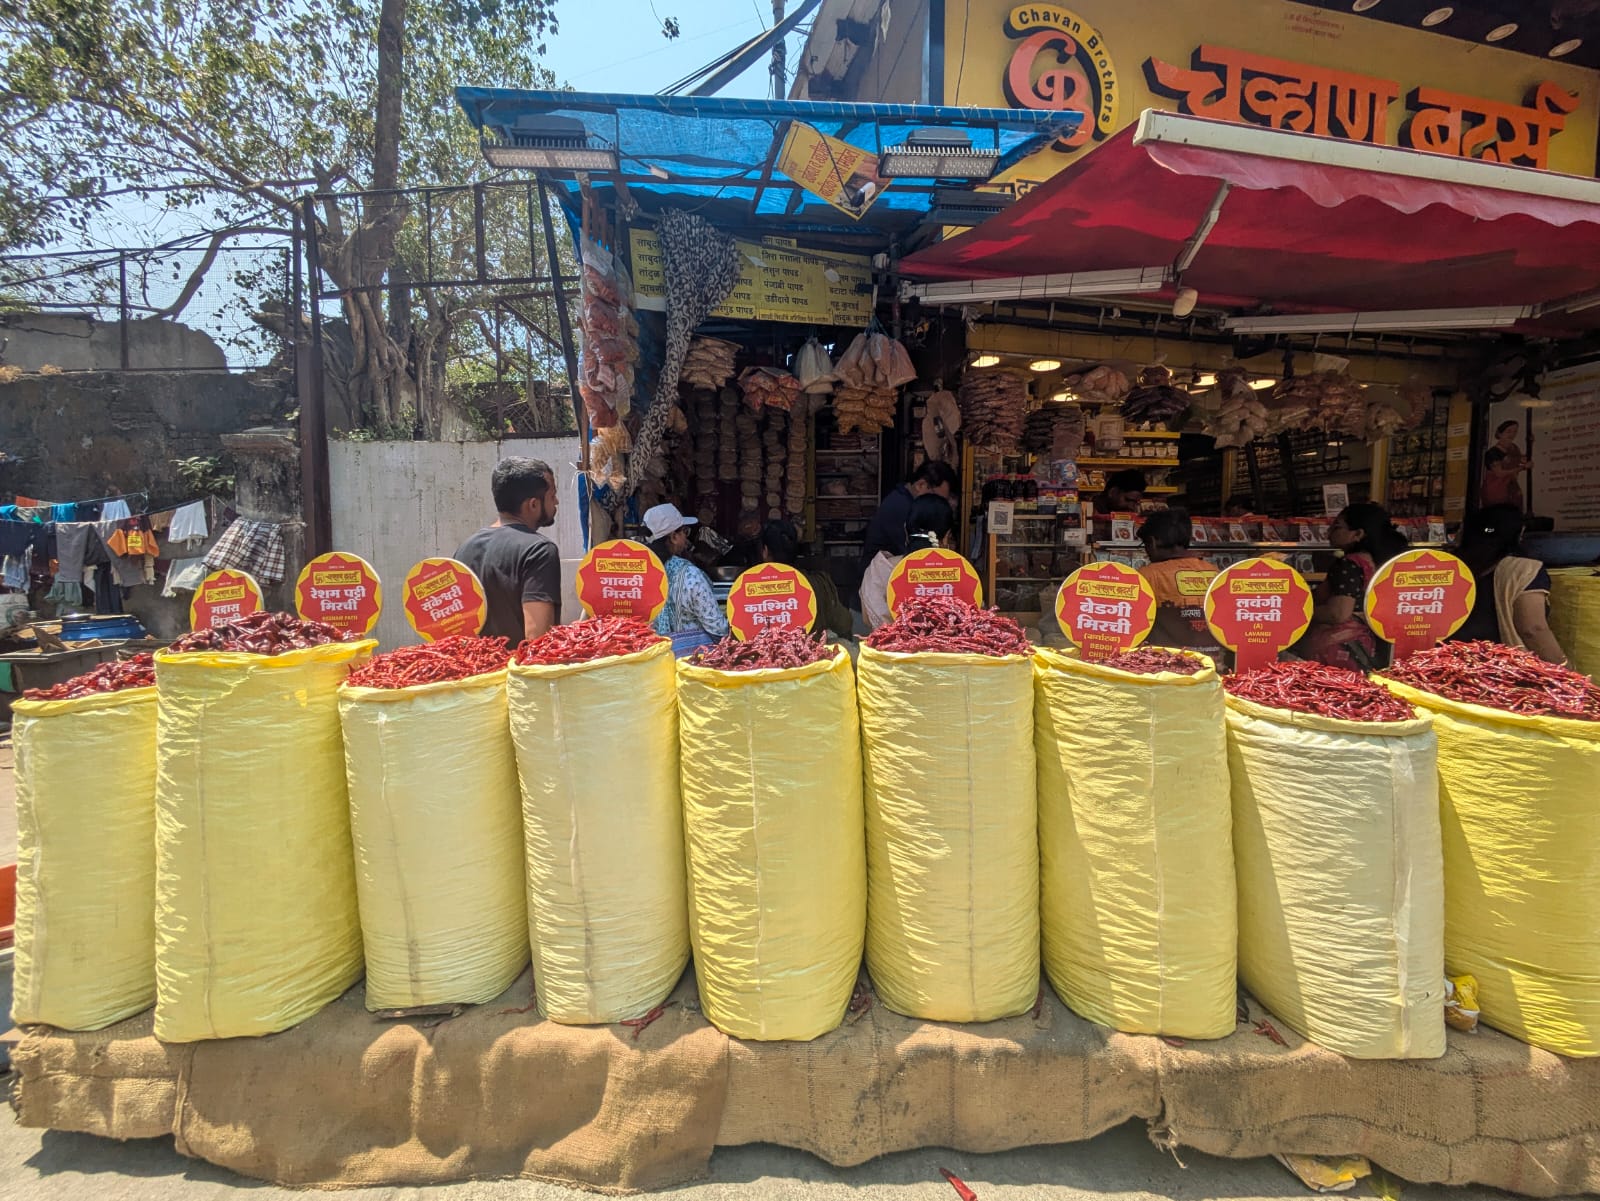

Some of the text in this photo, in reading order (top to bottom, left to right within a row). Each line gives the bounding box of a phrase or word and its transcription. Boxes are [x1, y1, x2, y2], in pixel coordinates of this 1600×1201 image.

[1018, 9, 1115, 124] Chavan Brothers
[600, 575, 644, 587] गावठी
[310, 587, 341, 599] रेशम
[602, 586, 642, 599] मिरची
[1397, 587, 1445, 600] लवंगी
[320, 599, 358, 611] मिरची
[1236, 595, 1282, 608] लवंगी
[1396, 600, 1443, 614] मिरची
[430, 598, 465, 621] मिरची
[1236, 608, 1282, 622] मिरची
[752, 611, 792, 626] मिरची
[1076, 613, 1132, 635] मिरची
